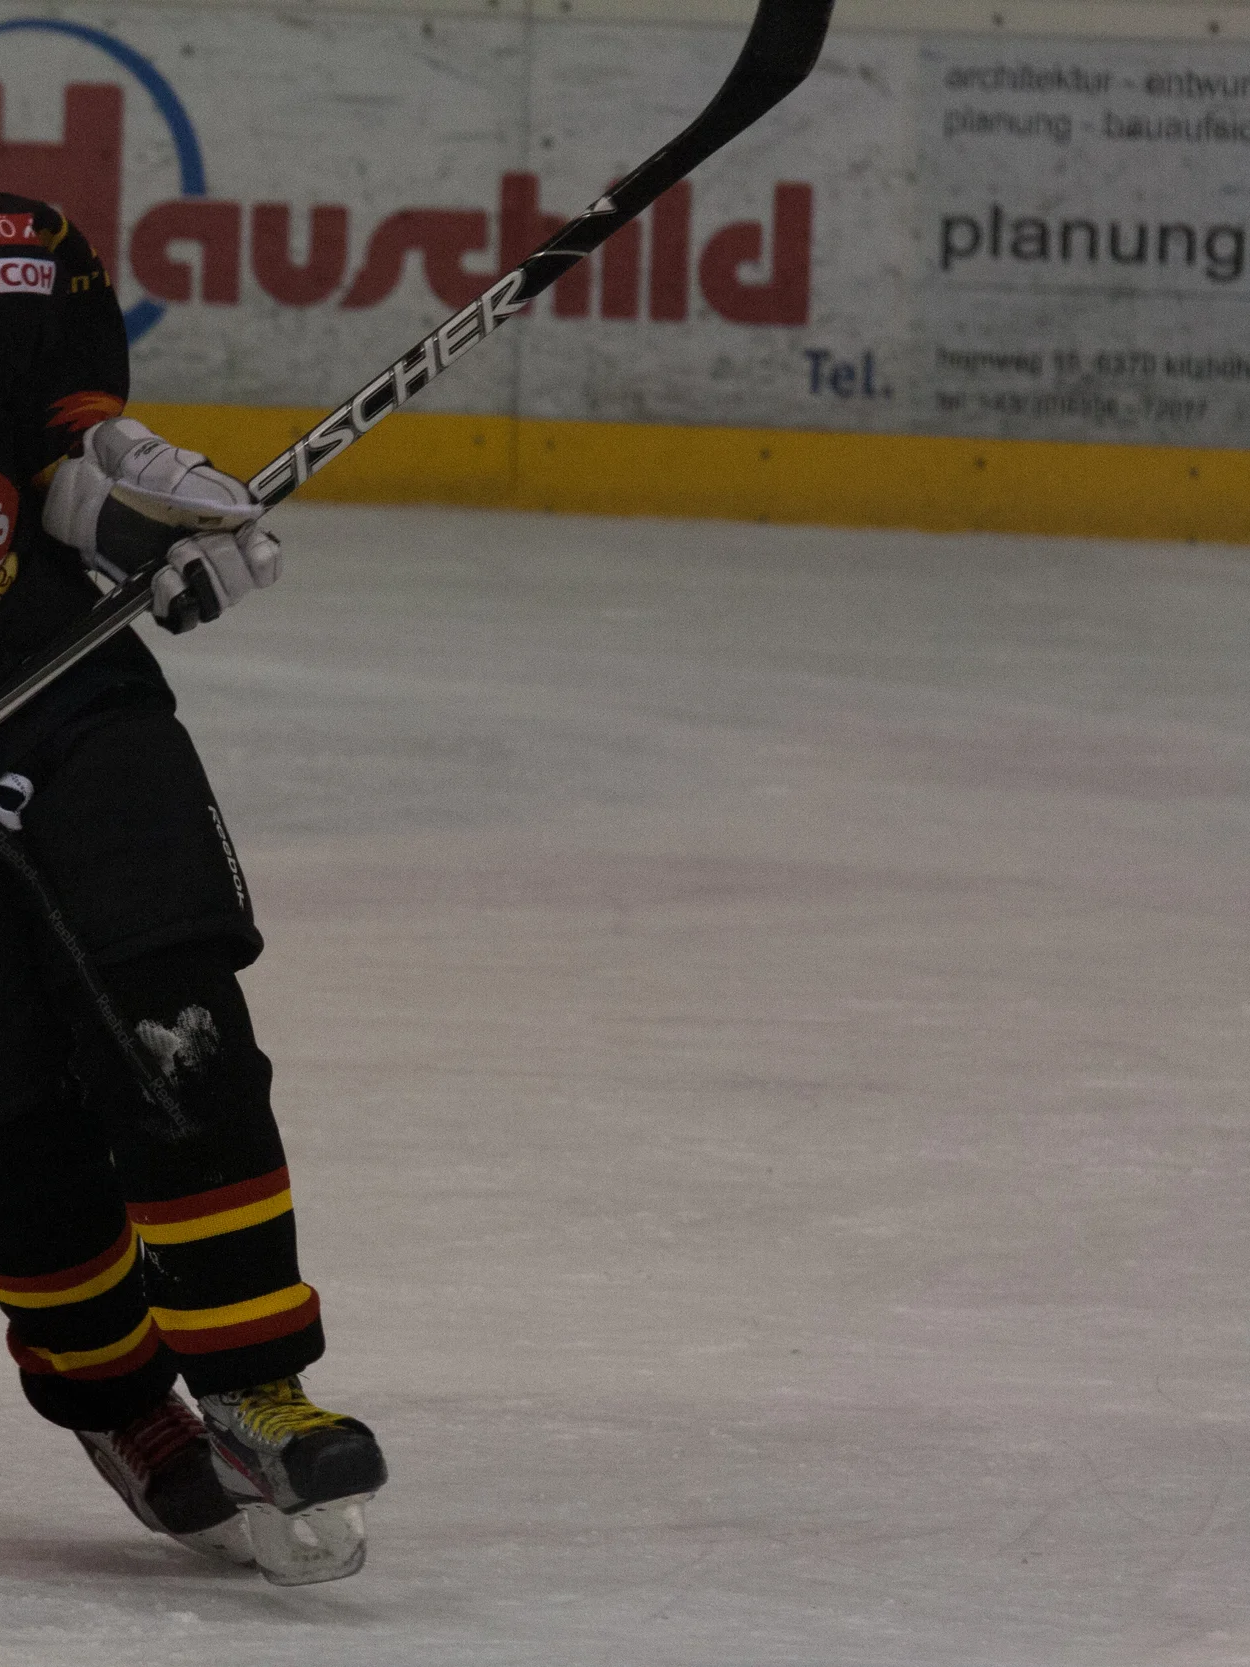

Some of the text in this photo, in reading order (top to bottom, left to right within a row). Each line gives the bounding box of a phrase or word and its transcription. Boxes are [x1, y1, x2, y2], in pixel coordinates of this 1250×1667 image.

[1144, 71, 1250, 98] entwur
[941, 204, 1247, 284] planung
[248, 269, 529, 502] FISCHER
[804, 348, 894, 400] Tel.
[97, 993, 136, 1052] Reebok
[152, 1076, 187, 1130] Reebo
